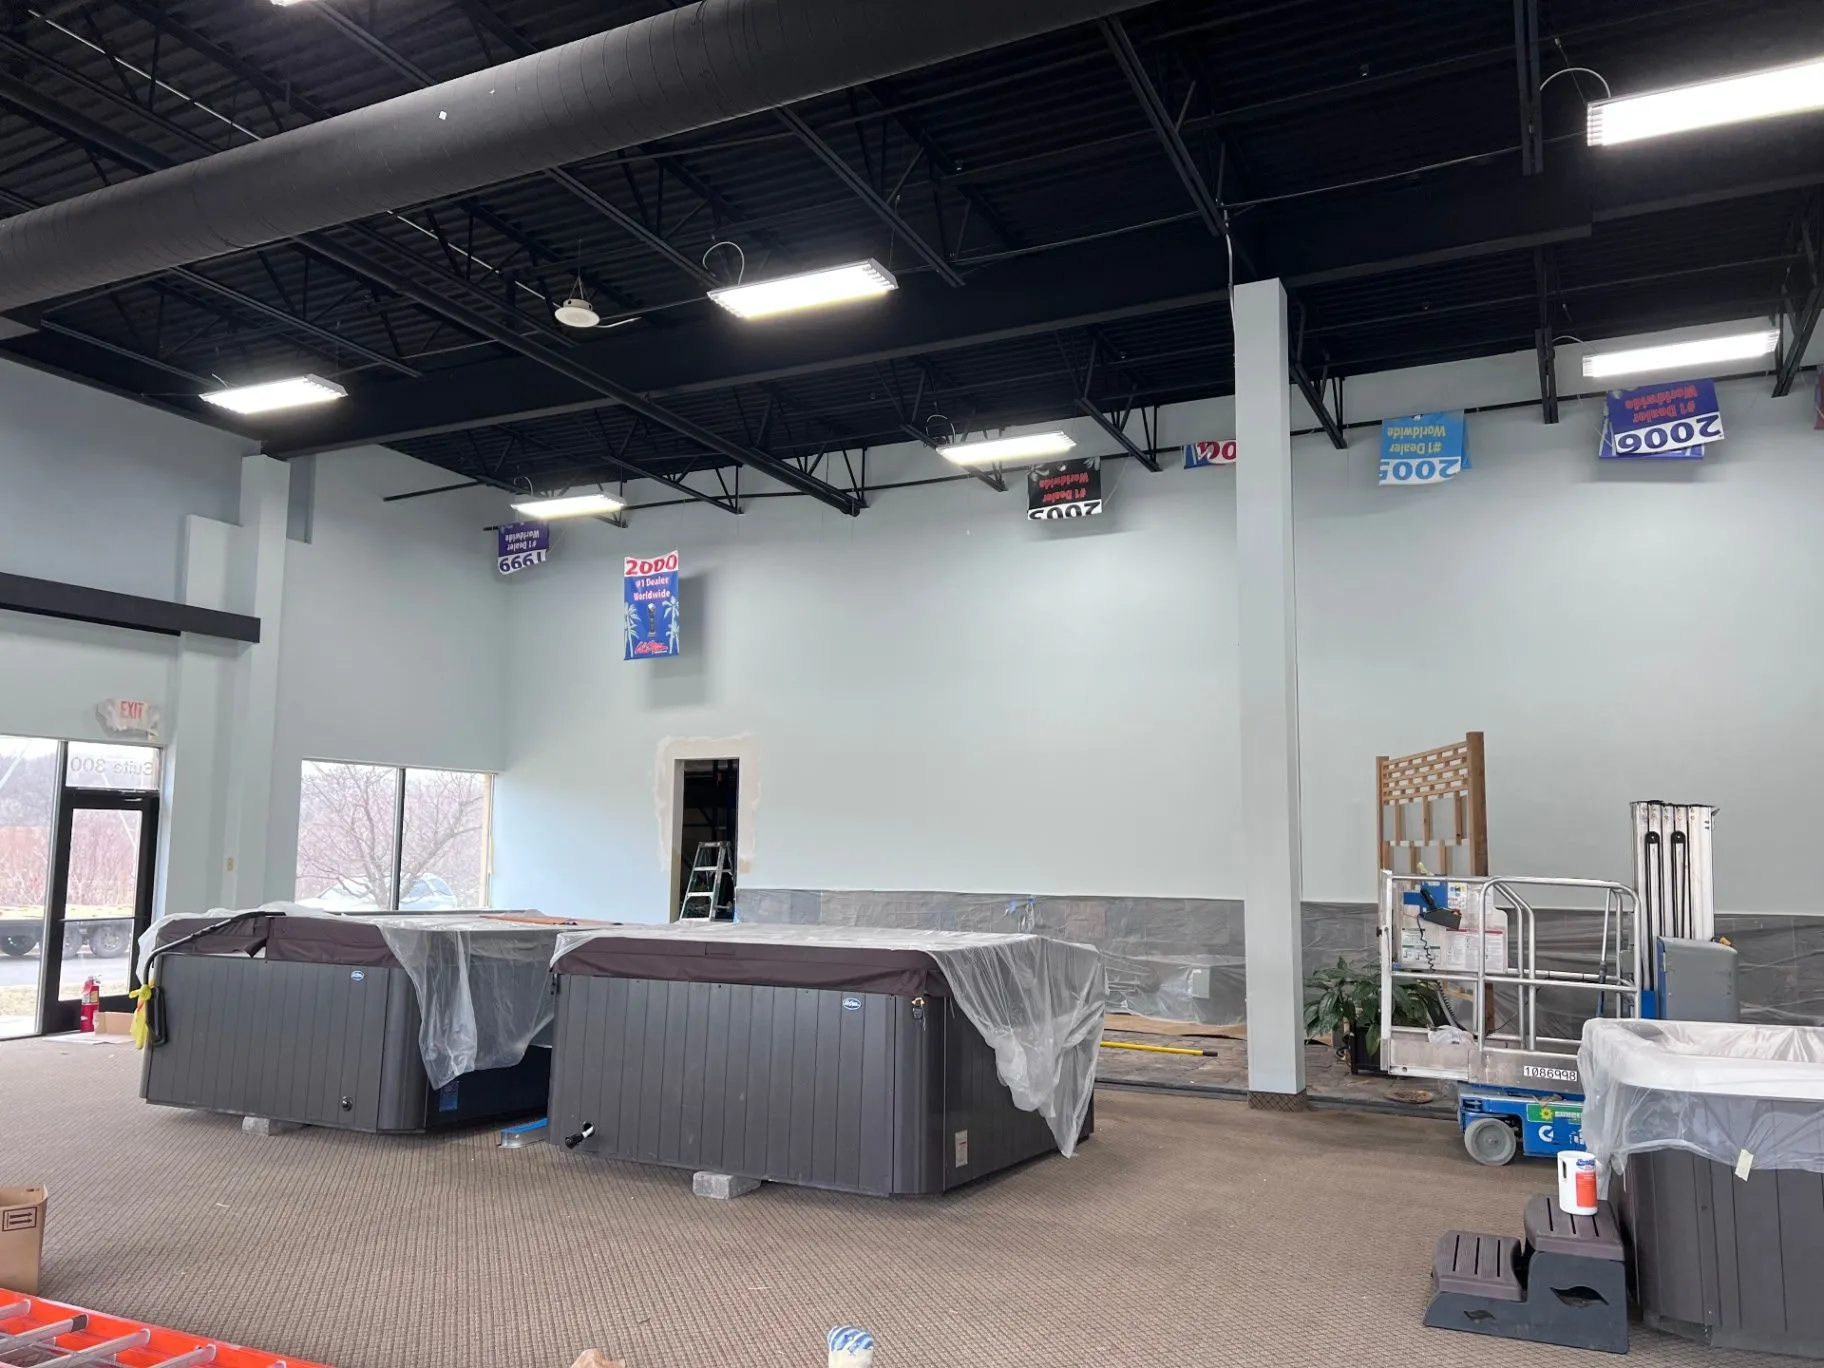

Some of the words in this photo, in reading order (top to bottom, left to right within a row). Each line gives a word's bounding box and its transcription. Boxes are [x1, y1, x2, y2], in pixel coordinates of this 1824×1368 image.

[1624, 385, 1698, 410] Worldwide
[1632, 404, 1677, 423] Dealer
[1680, 399, 1696, 415] #1
[1387, 425, 1446, 439] Worldwide
[1617, 414, 1722, 453] 2006
[1389, 442, 1426, 455] Dealer
[1428, 441, 1443, 454] #1
[1039, 472, 1089, 490] Worldwide
[1042, 489, 1073, 503] Dealer
[1074, 487, 1087, 499] #1
[504, 530, 540, 542] Worldwide
[507, 541, 527, 551] Dealer
[499, 551, 542, 573] 1999
[625, 554, 678, 575] 2000
[645, 576, 669, 587] Dealer
[633, 589, 671, 601] Worldwide
[120, 700, 144, 719] EXIT
[1525, 1066, 1577, 1081] 1086998
